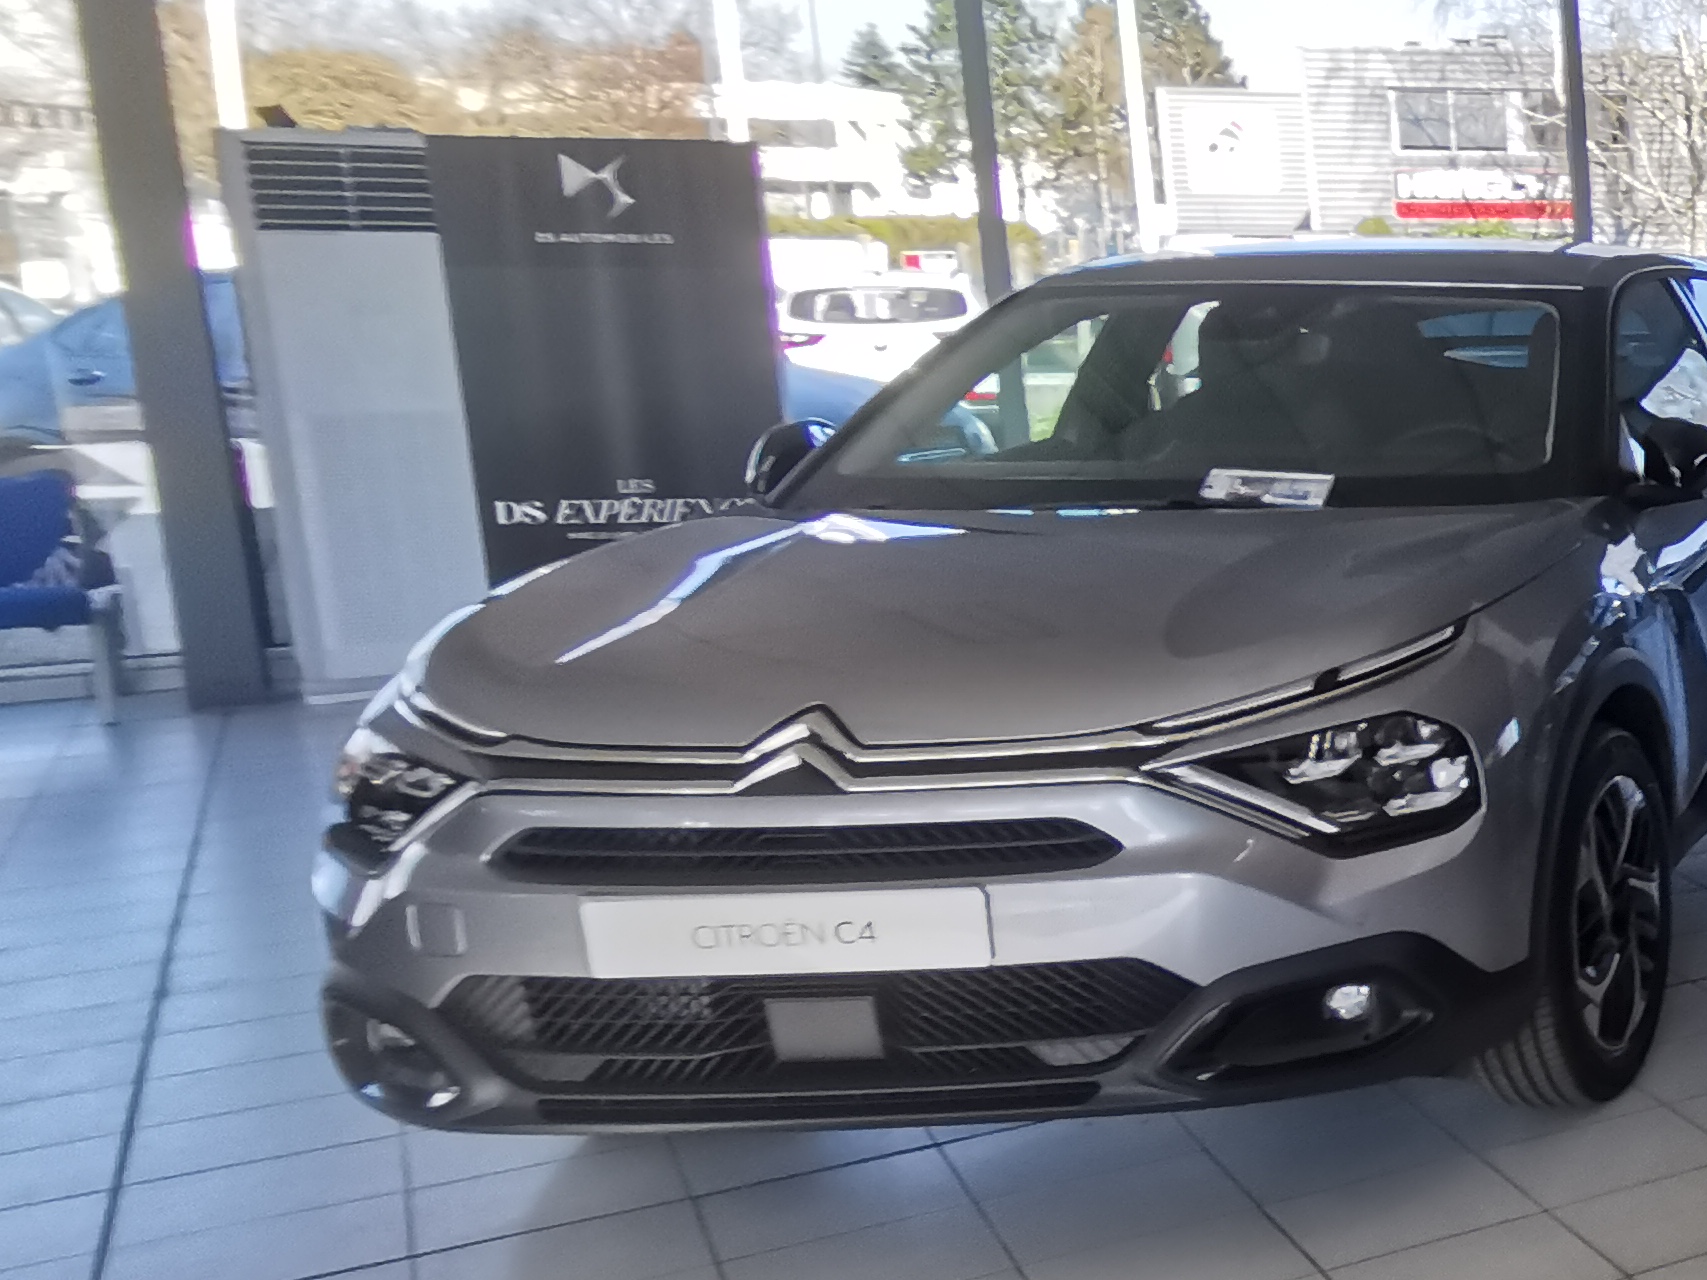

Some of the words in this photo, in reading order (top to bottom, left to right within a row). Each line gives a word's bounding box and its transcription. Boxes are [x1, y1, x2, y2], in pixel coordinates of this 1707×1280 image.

[494, 499, 549, 525] DS
[692, 919, 825, 950] CITROËN
[834, 920, 876, 945] C4
